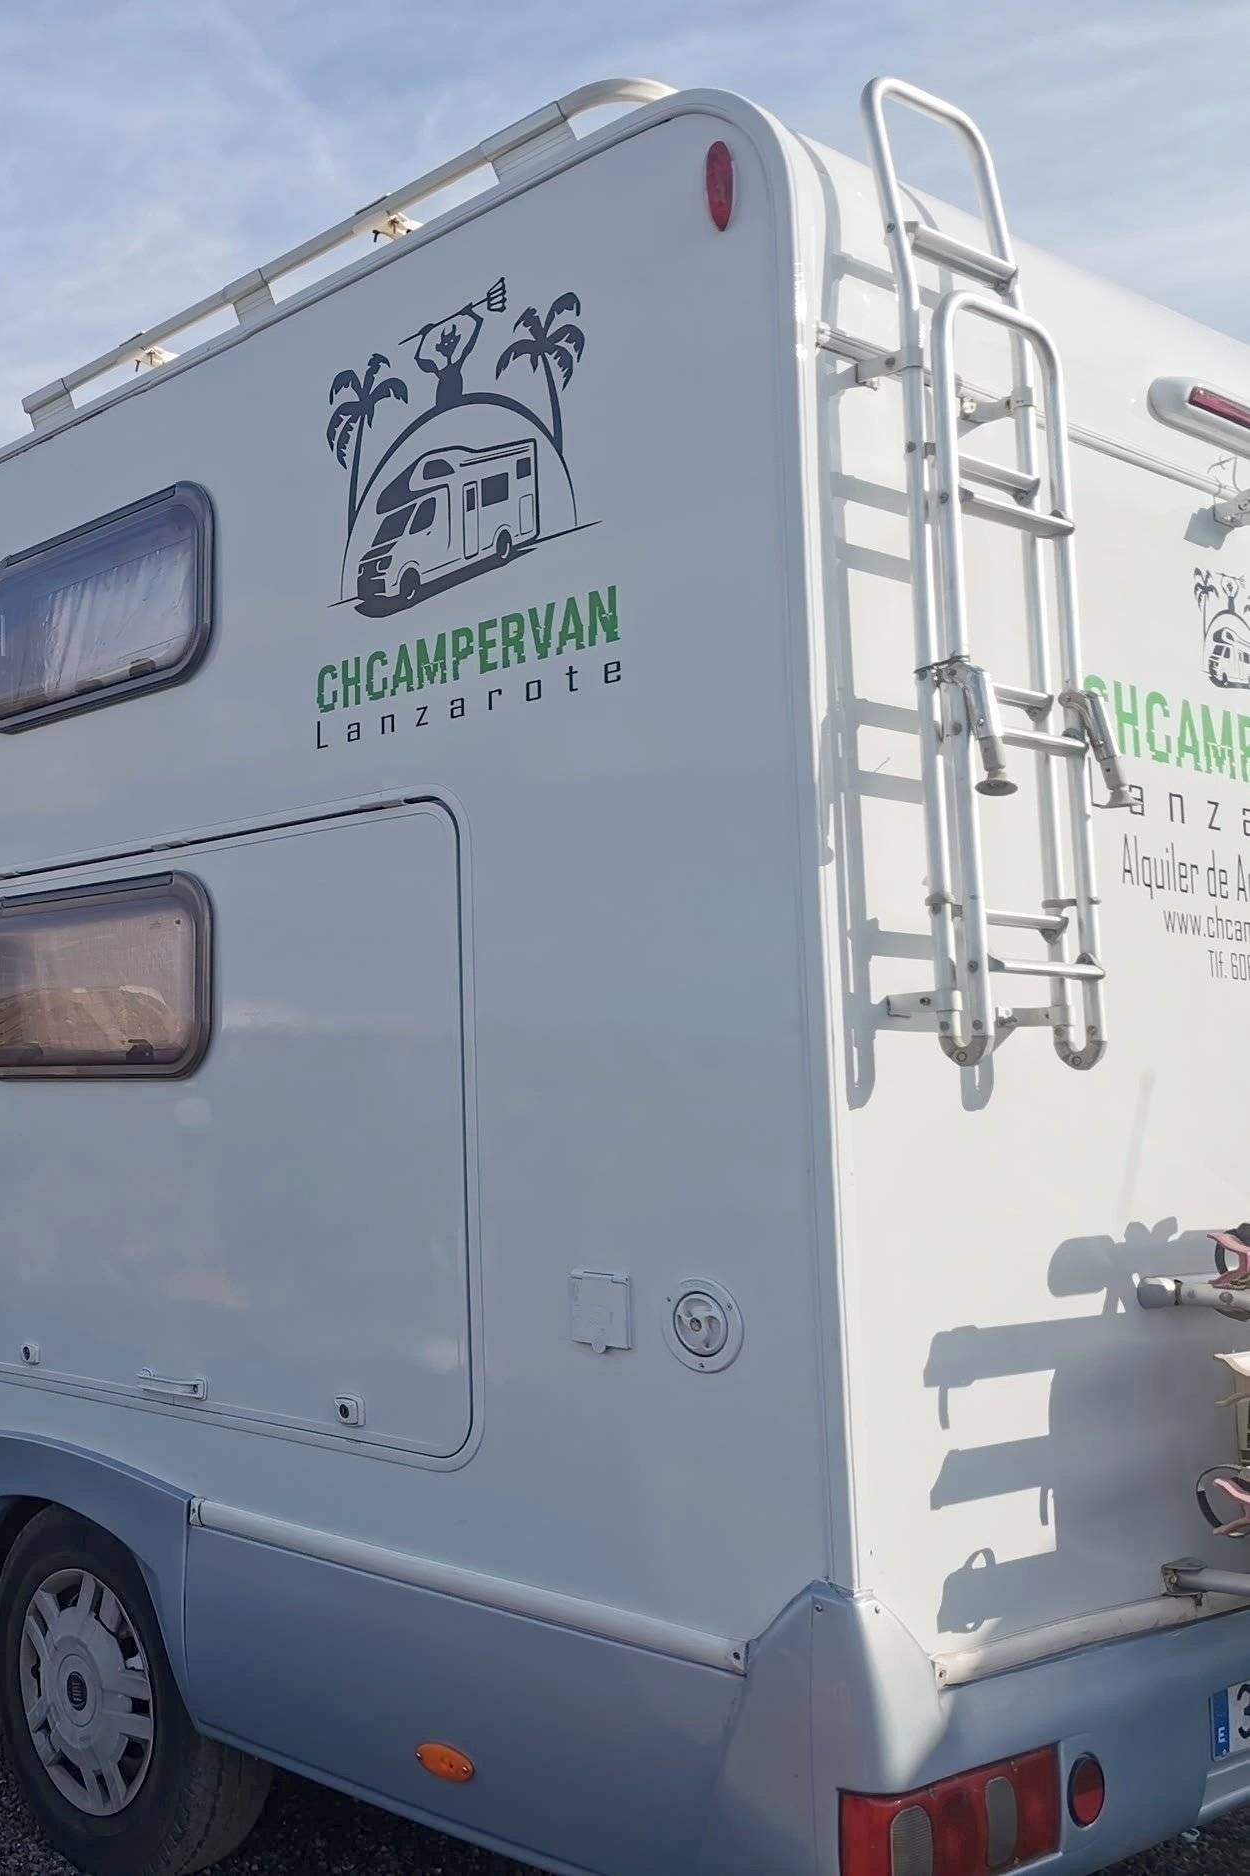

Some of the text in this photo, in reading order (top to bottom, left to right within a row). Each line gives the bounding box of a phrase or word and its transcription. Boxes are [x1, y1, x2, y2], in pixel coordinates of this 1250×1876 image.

[316, 585, 621, 714] CHCAMPERVAN
[315, 660, 622, 750] Lanzarote
[1122, 833, 1250, 902] Alquiler de A
[1230, 952, 1250, 982] 60
[1218, 1726, 1226, 1744] E
